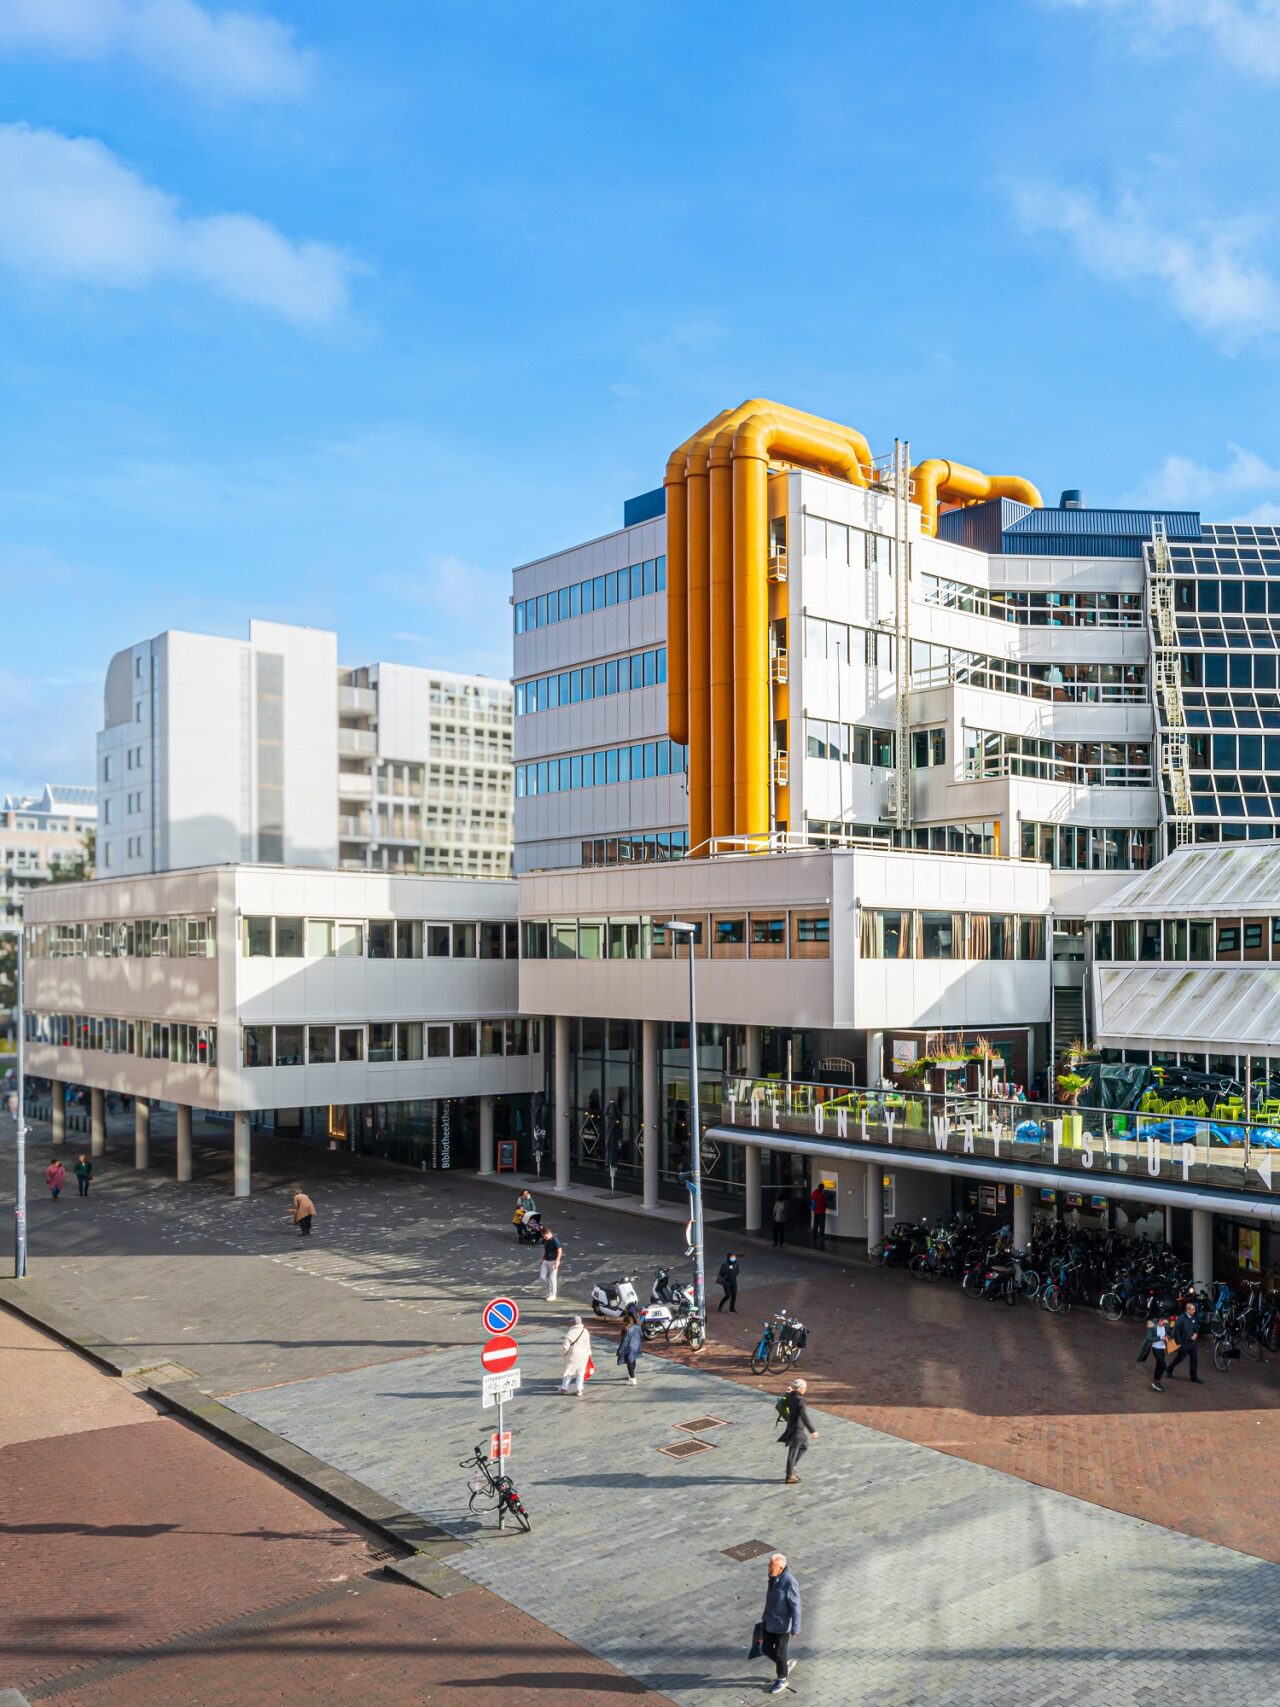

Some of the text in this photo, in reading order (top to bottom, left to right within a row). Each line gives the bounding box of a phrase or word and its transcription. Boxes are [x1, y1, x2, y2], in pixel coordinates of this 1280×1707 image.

[729, 1096, 1196, 1181] THE ONLY WAY IS UP
